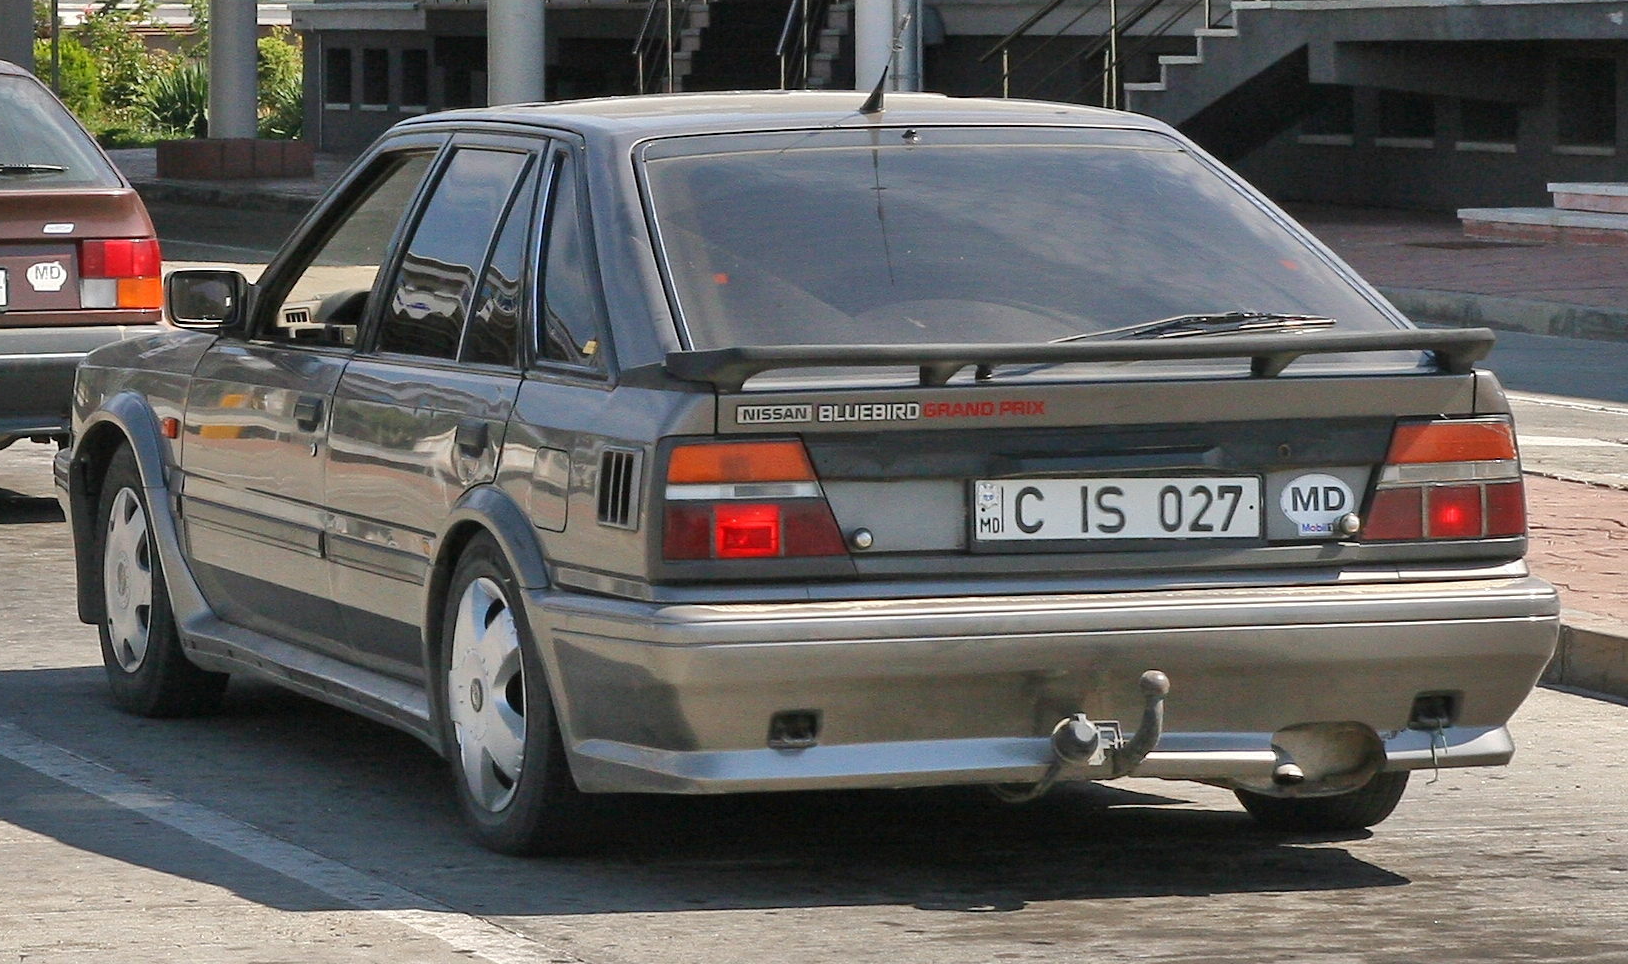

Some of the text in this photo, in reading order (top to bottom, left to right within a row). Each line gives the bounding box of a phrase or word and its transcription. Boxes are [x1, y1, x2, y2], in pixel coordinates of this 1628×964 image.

[35, 265, 61, 280] MD
[742, 400, 1046, 422] NISSAN BLUEBIRD GRAND PRIX
[1015, 484, 1244, 534] C IS 027
[1291, 486, 1346, 512] MD
[979, 517, 1001, 534] MD
